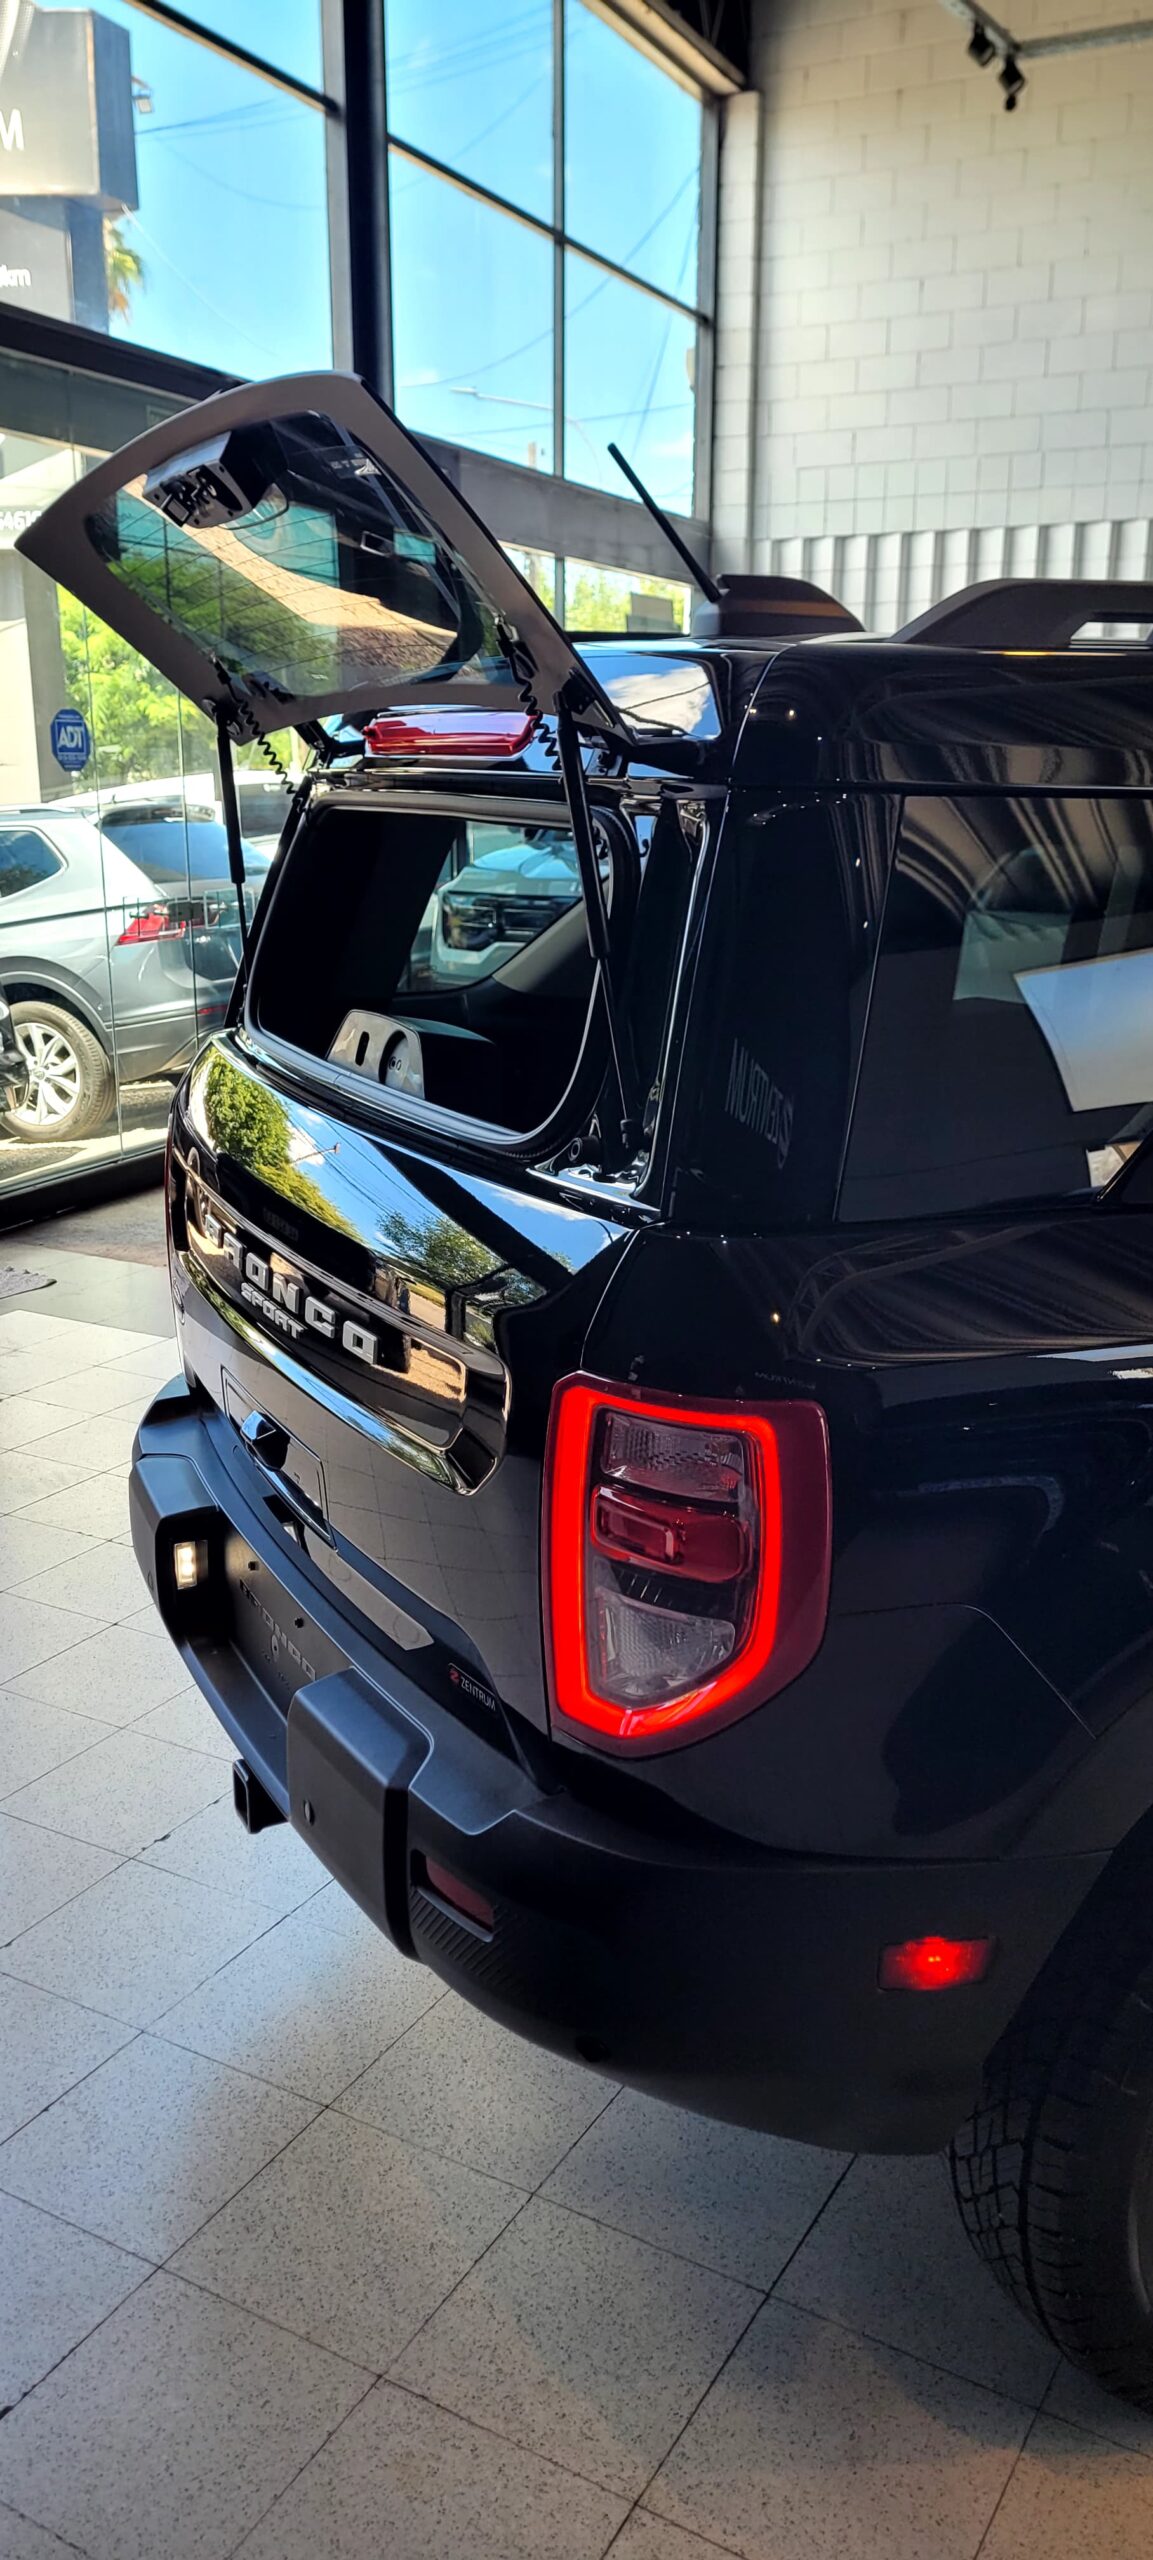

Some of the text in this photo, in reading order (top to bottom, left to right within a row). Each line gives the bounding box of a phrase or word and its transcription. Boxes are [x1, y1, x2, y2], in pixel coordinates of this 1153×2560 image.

[58, 726, 84, 749] ADT
[204, 1213, 378, 1365] BRONCO
[240, 1282, 305, 1339] SPORT
[460, 1675, 496, 1711] ZENTRUM
